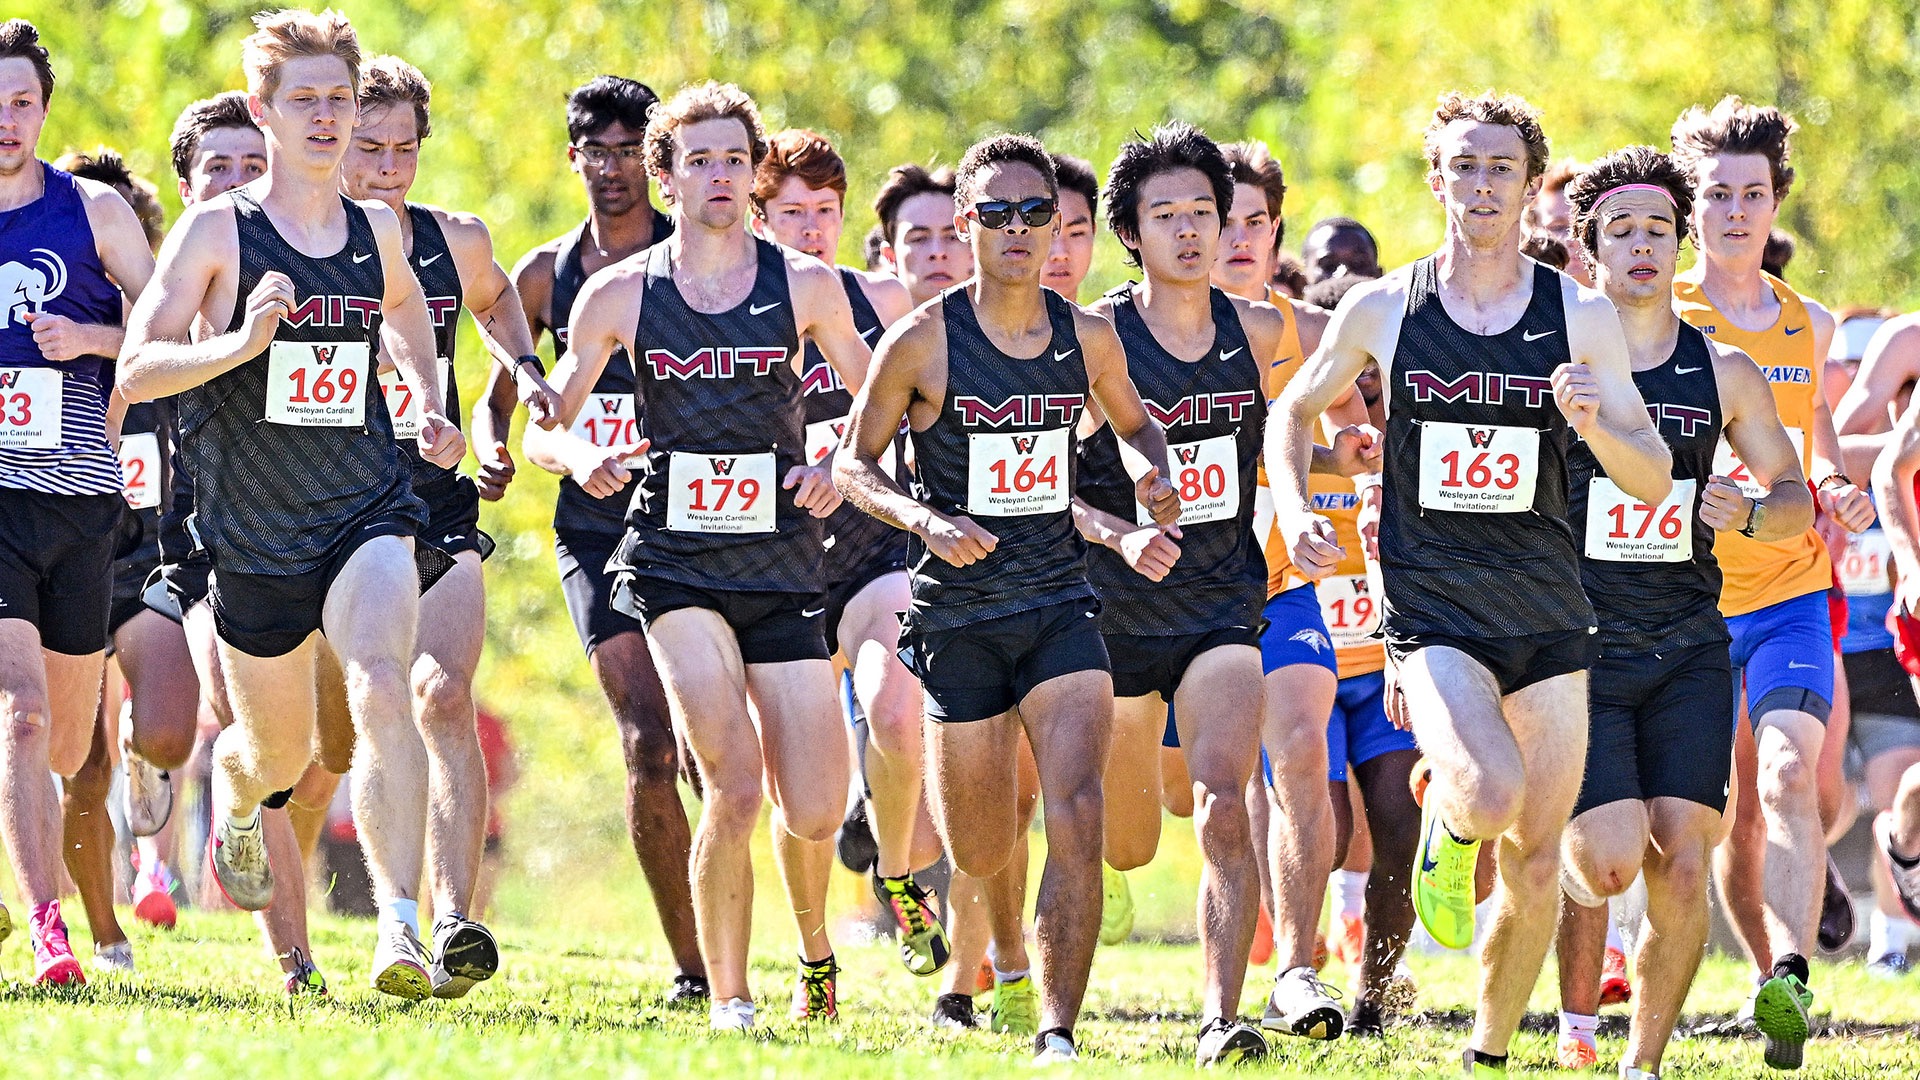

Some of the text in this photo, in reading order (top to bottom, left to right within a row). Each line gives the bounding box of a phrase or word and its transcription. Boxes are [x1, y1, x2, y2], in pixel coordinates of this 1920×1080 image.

[279, 295, 381, 329] MIT
[645, 347, 788, 381] MIT
[289, 367, 358, 404] 169
[1405, 370, 1554, 408] MIT
[286, 405, 355, 416] Wesleyan Cardinal
[954, 393, 1085, 428] MIT
[1143, 390, 1256, 431] MIT
[300, 416, 343, 425] Invitational
[9, 429, 42, 437] Cardinal
[989, 455, 1059, 494] 164
[1440, 450, 1520, 490] 163
[1179, 463, 1226, 502] 80
[687, 478, 761, 512] 179
[988, 493, 1057, 506] Wesleyan Cardinal
[1311, 493, 1360, 509] NEW
[1438, 490, 1515, 502] Wesleyan Cardinal
[1003, 504, 1043, 514] Invitational
[1194, 500, 1226, 511] Cardinal
[1453, 501, 1499, 511] Invitational
[687, 513, 758, 523] Wesleyan Cardinal
[1607, 503, 1683, 540] 176
[700, 523, 743, 532] Invitational
[1605, 541, 1679, 552] Wesleyan Cardinal
[1620, 552, 1665, 561] Invitational
[1329, 596, 1377, 628] 19
